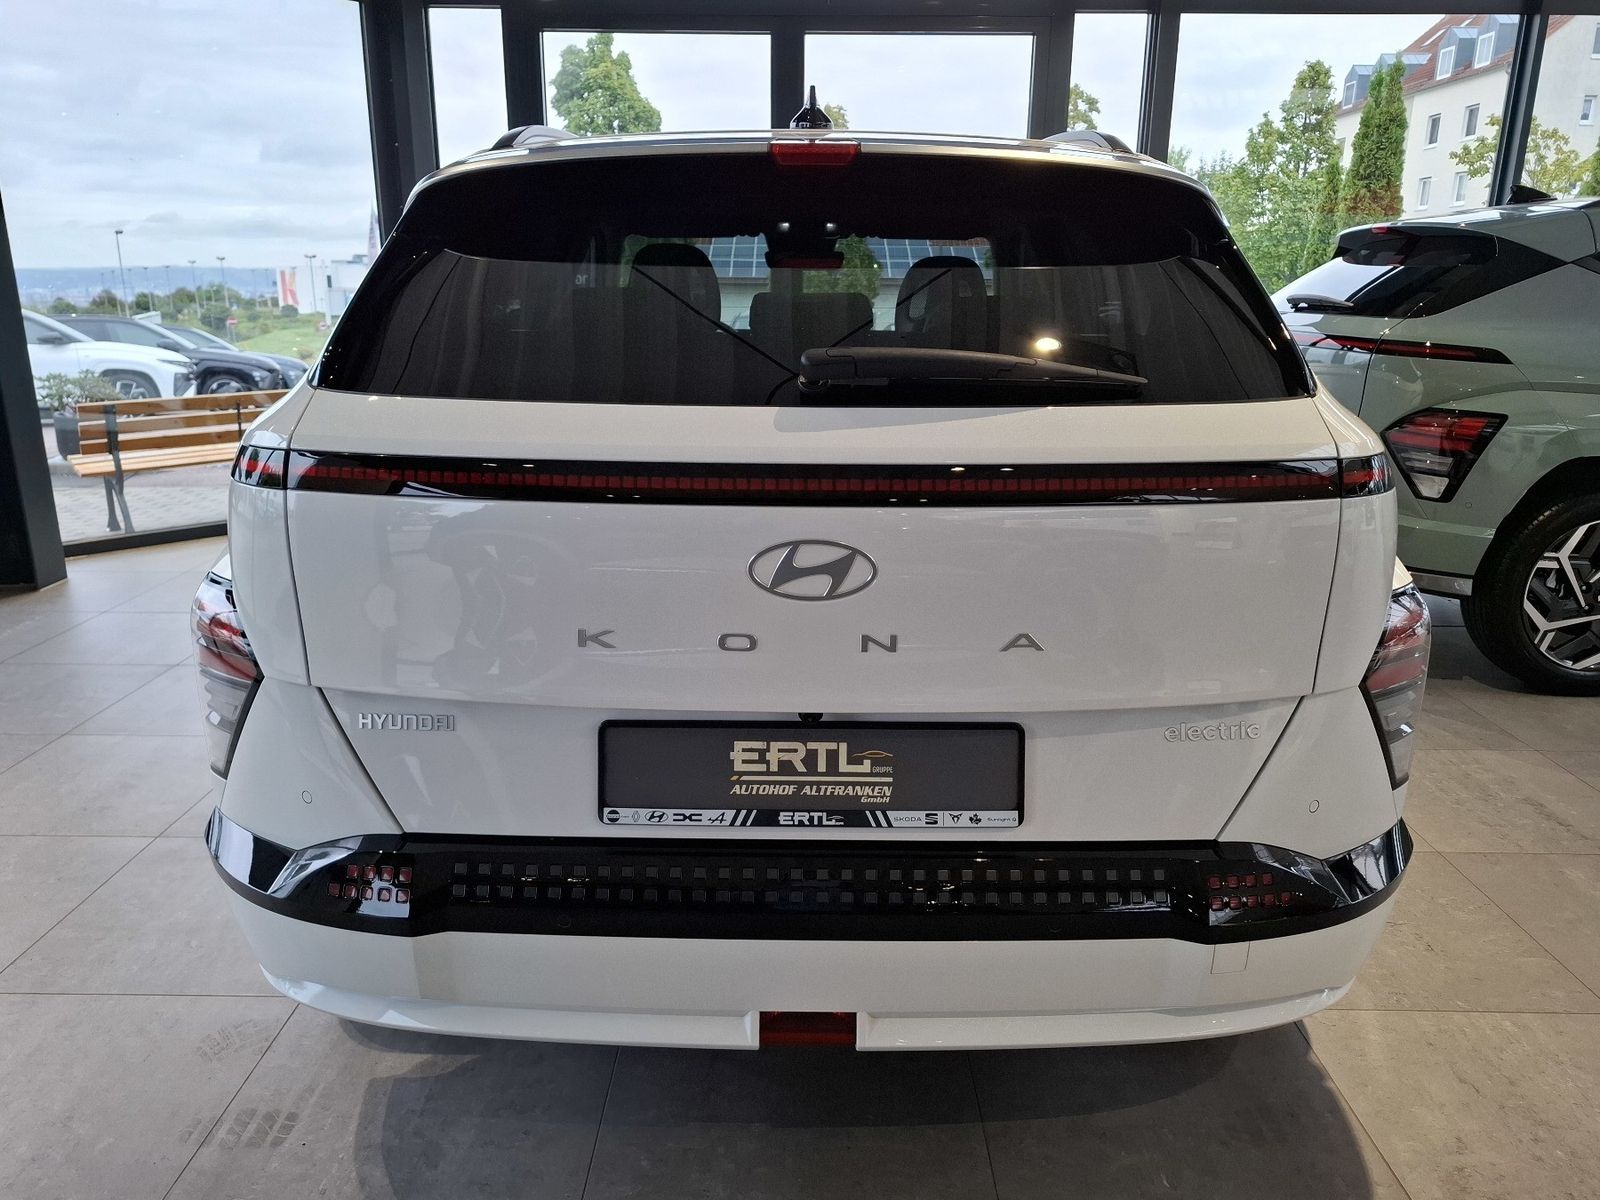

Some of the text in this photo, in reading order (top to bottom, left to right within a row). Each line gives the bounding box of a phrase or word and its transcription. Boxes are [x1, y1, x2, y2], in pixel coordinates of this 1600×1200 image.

[577, 627, 1046, 653] KONA
[359, 713, 455, 731] HYUNDAI
[1163, 721, 1260, 742] electric
[730, 741, 871, 773] ERTL
[730, 784, 893, 797] AUTOHOF ALTFRANKEN
[778, 811, 844, 826] ERTL
